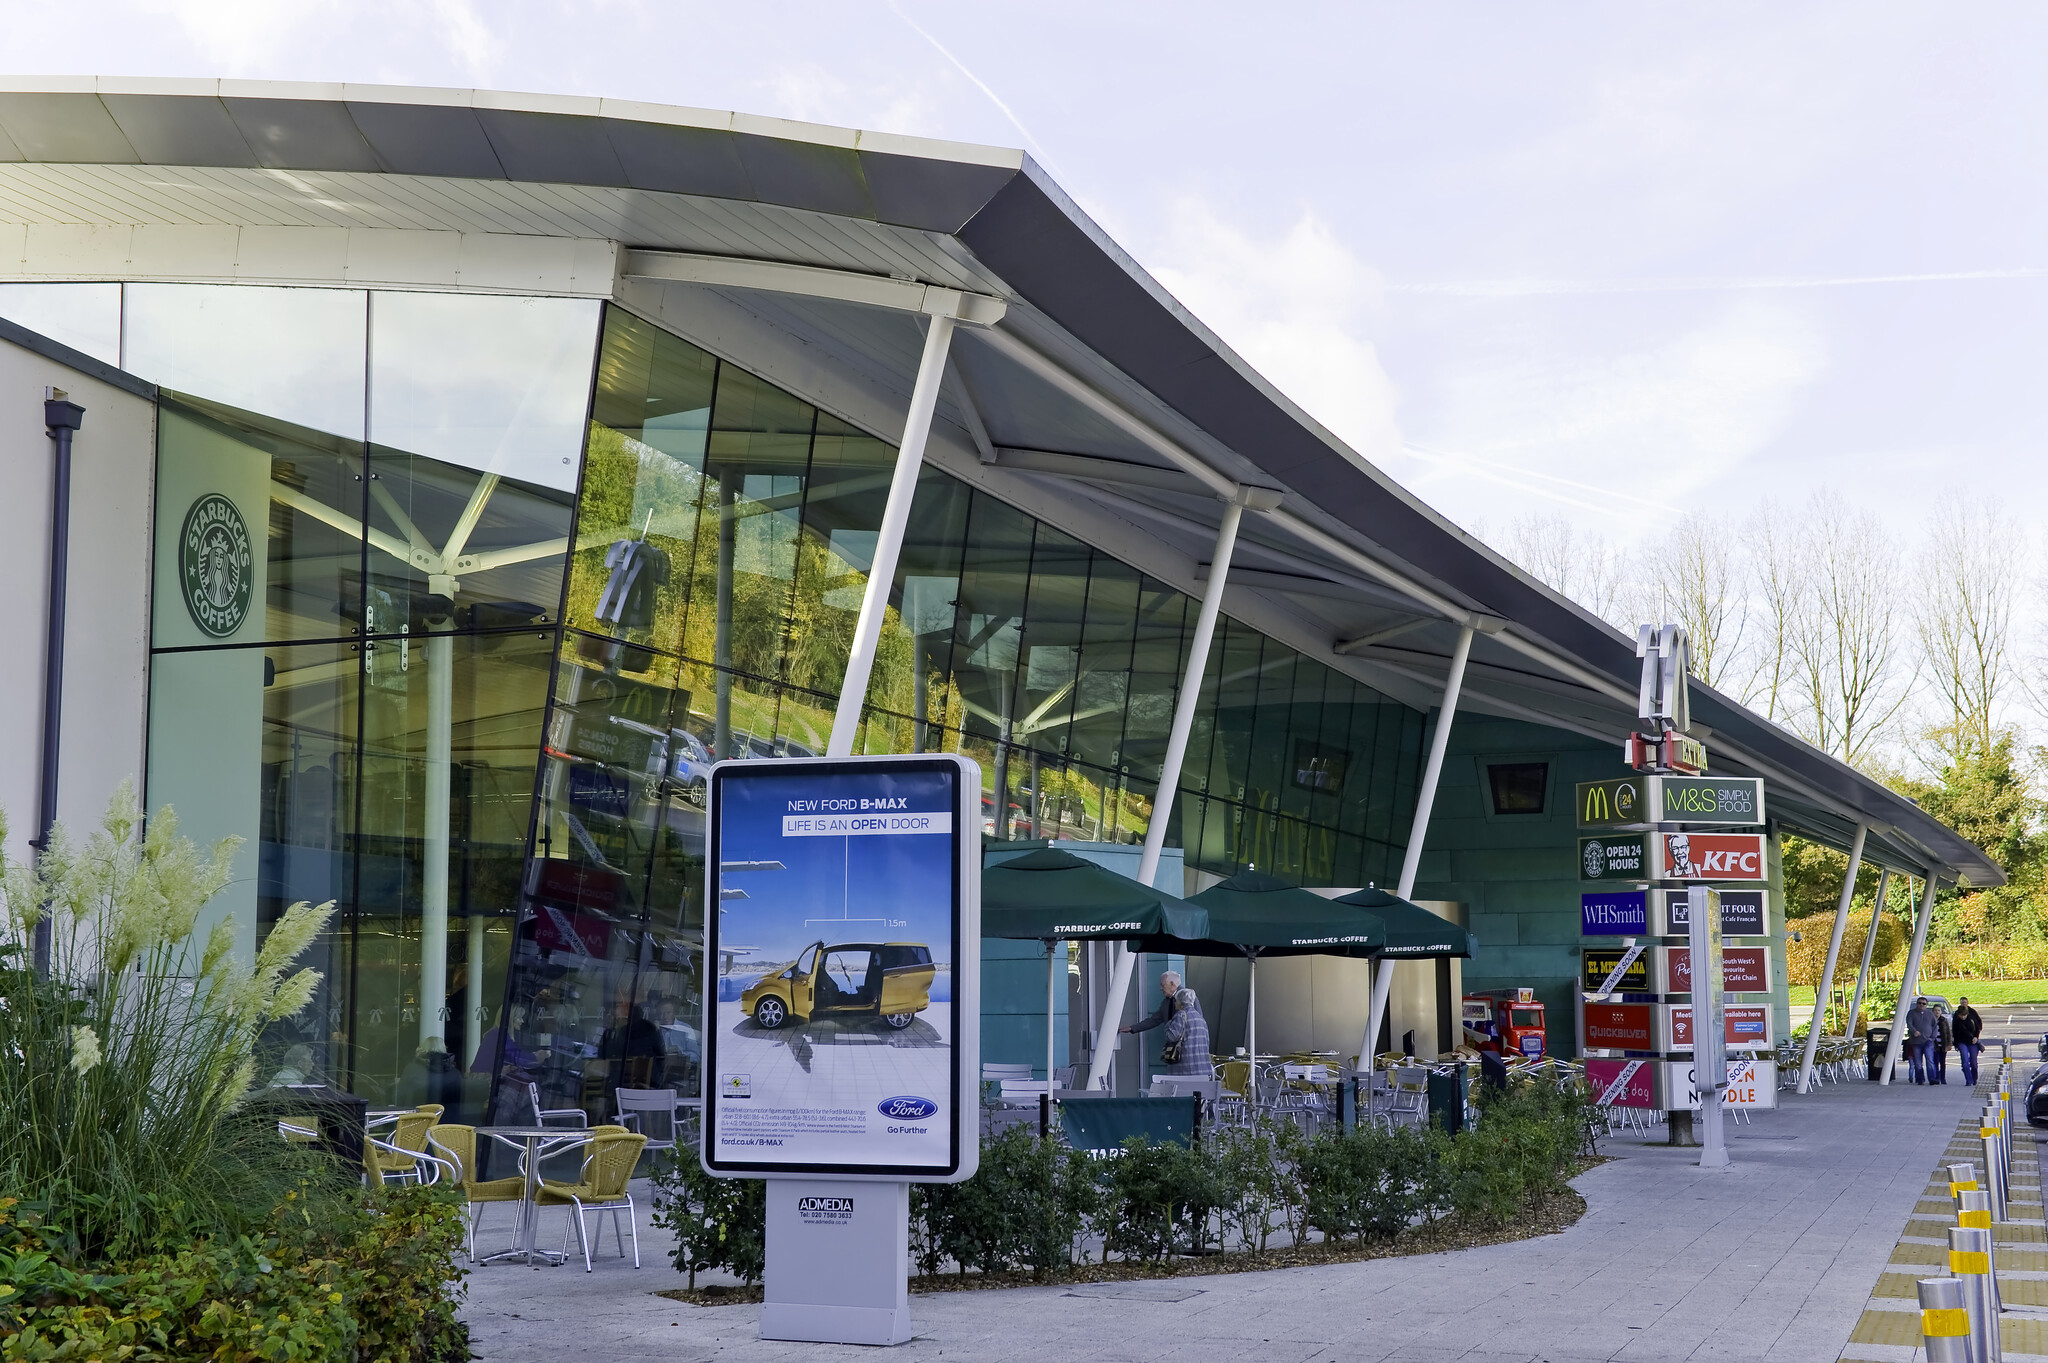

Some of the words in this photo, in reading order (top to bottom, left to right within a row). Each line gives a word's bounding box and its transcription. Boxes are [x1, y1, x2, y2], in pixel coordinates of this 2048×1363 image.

[188, 502, 250, 568] STARBUCKS
[193, 588, 241, 630] COFFEE
[787, 799, 818, 812] NEW
[821, 798, 858, 811] FORD
[860, 797, 908, 810] B-MAX
[1667, 788, 1717, 812] M&S
[1717, 789, 1752, 801] SIMPLY
[1718, 801, 1752, 813] FOOD
[787, 820, 812, 832] LIFE
[814, 819, 826, 831] IS
[829, 819, 848, 831] AN
[851, 818, 887, 830] OPEN
[891, 817, 930, 830] DOOR
[1606, 846, 1630, 858] OPEN
[1630, 844, 1642, 856] 24
[1609, 858, 1640, 871] HOURS
[1702, 850, 1758, 872] KFC
[1584, 904, 1645, 924] WHSmith
[1732, 904, 1756, 914] FOUR
[888, 919, 907, 928] 1.5m
[1053, 924, 1107, 933] STARBUCKS
[1108, 922, 1142, 930] COFFEE
[1292, 937, 1339, 945] STARBUCKS
[1385, 945, 1426, 953] STARBUCKS
[1621, 948, 1637, 969] SOON
[1588, 961, 1599, 974] EL
[1589, 1025, 1648, 1040] QUICKSILVER
[1729, 1059, 1751, 1081] SOON
[1601, 1079, 1624, 1107] OPENING
[1622, 1061, 1637, 1081] SOON
[1631, 1083, 1650, 1102] dog
[889, 1098, 926, 1117] Ford
[887, 1126, 899, 1134] Go
[900, 1126, 928, 1135] Further
[721, 1137, 783, 1147] ford.co.uk/B-MAX
[800, 1198, 852, 1211] ADMEDIA
